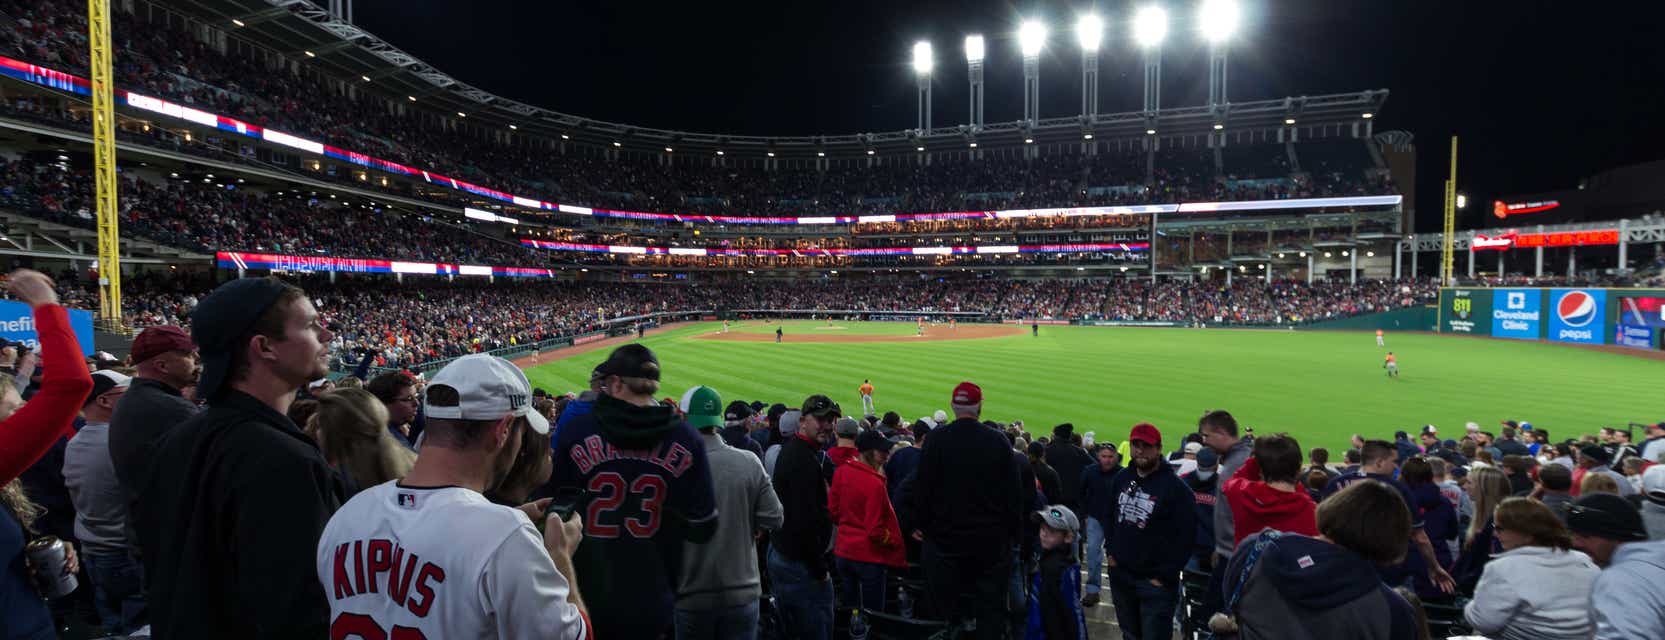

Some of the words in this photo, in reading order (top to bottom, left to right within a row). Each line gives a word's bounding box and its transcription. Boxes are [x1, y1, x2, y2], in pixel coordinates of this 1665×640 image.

[1453, 298, 1471, 312] 811
[1494, 309, 1539, 320] Cleveland
[1502, 320, 1529, 330] Clinic
[1559, 329, 1592, 340] pepsi
[585, 472, 668, 538] 23
